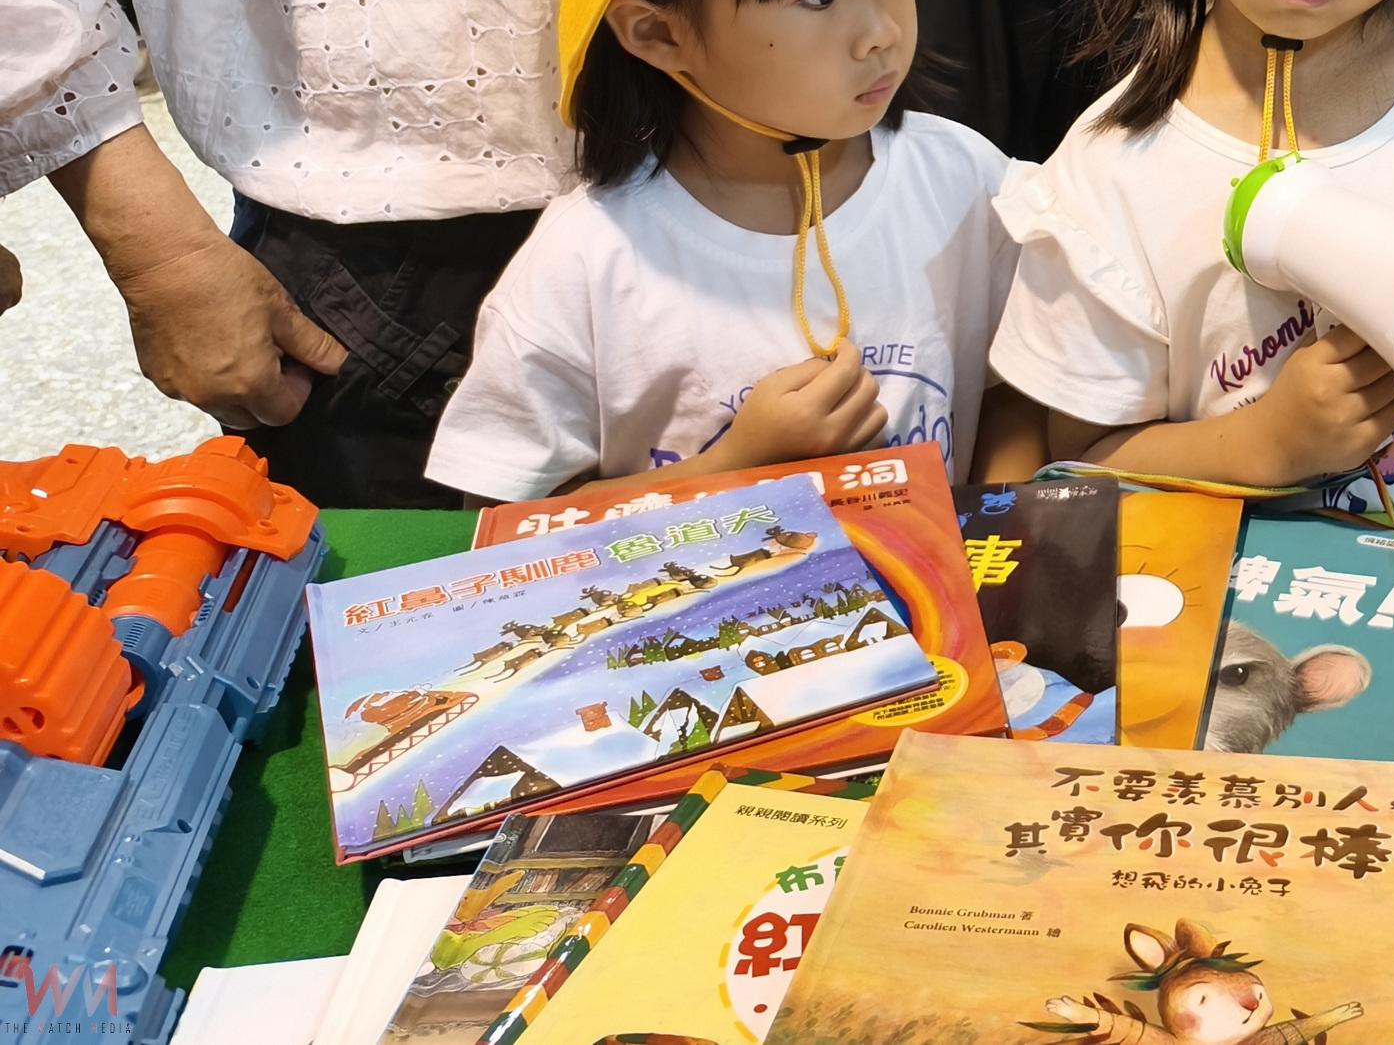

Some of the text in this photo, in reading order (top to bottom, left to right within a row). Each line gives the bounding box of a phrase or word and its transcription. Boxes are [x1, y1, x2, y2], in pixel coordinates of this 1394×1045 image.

[1210, 298, 1316, 393] Kuromi
[344, 505, 779, 627] 紅鼻子馴鹿魯道夫
[735, 803, 849, 830] 親親閱讀系列
[775, 855, 848, 894] 布
[1110, 869, 1292, 898] 想飛的小兔子
[909, 905, 954, 917] Bonnie
[956, 908, 1016, 920] Grubman
[903, 920, 957, 932] Carolien
[961, 924, 1039, 937] Westermann
